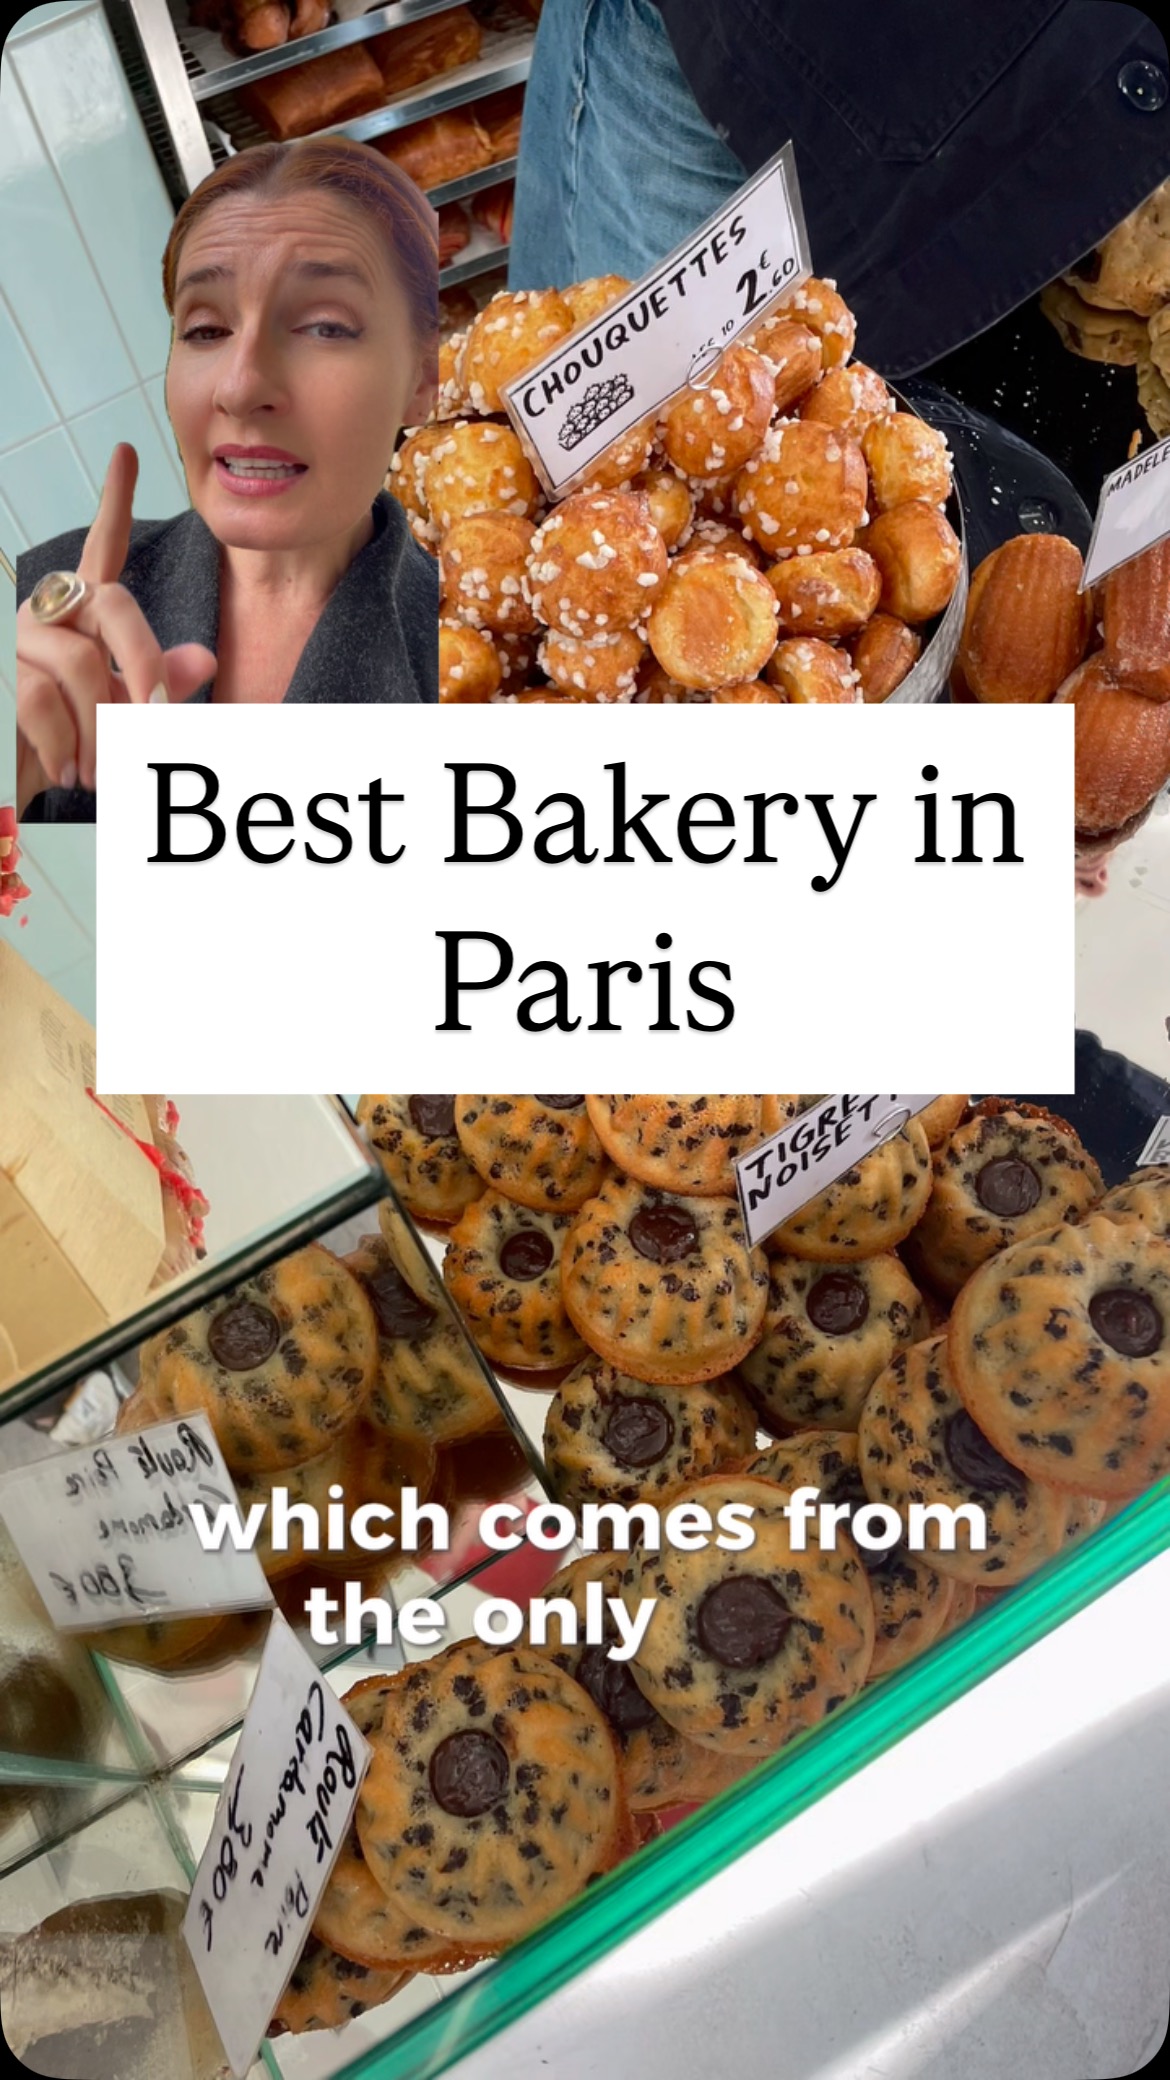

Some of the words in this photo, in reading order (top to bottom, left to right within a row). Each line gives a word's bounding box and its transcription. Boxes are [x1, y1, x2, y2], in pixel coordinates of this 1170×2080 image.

[523, 215, 747, 417] CHOUQUETTES
[721, 319, 735, 336] 10
[748, 1094, 898, 1211] NOISET
